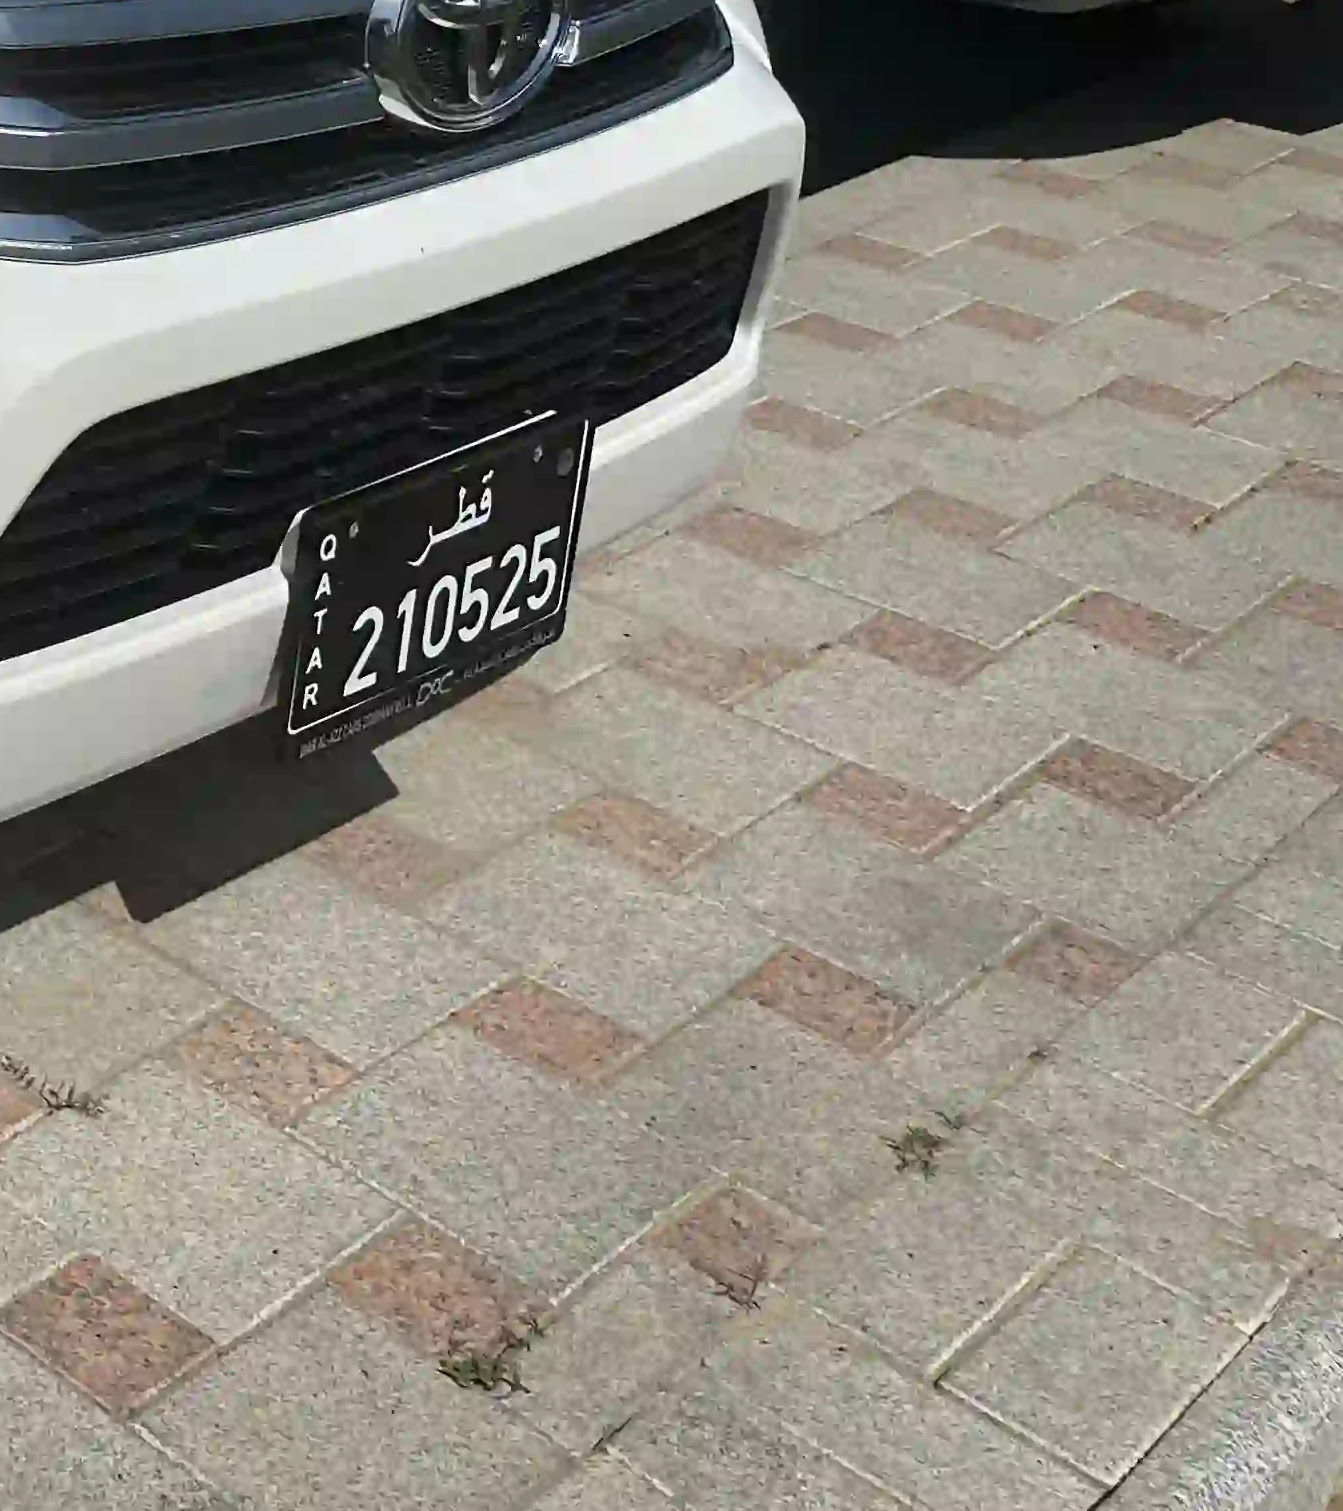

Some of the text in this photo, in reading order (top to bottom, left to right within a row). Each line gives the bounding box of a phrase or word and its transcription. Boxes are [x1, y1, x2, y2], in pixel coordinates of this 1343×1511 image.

[407, 469, 495, 568] قطر
[302, 534, 337, 710] QATAR
[343, 525, 562, 698] 210525
